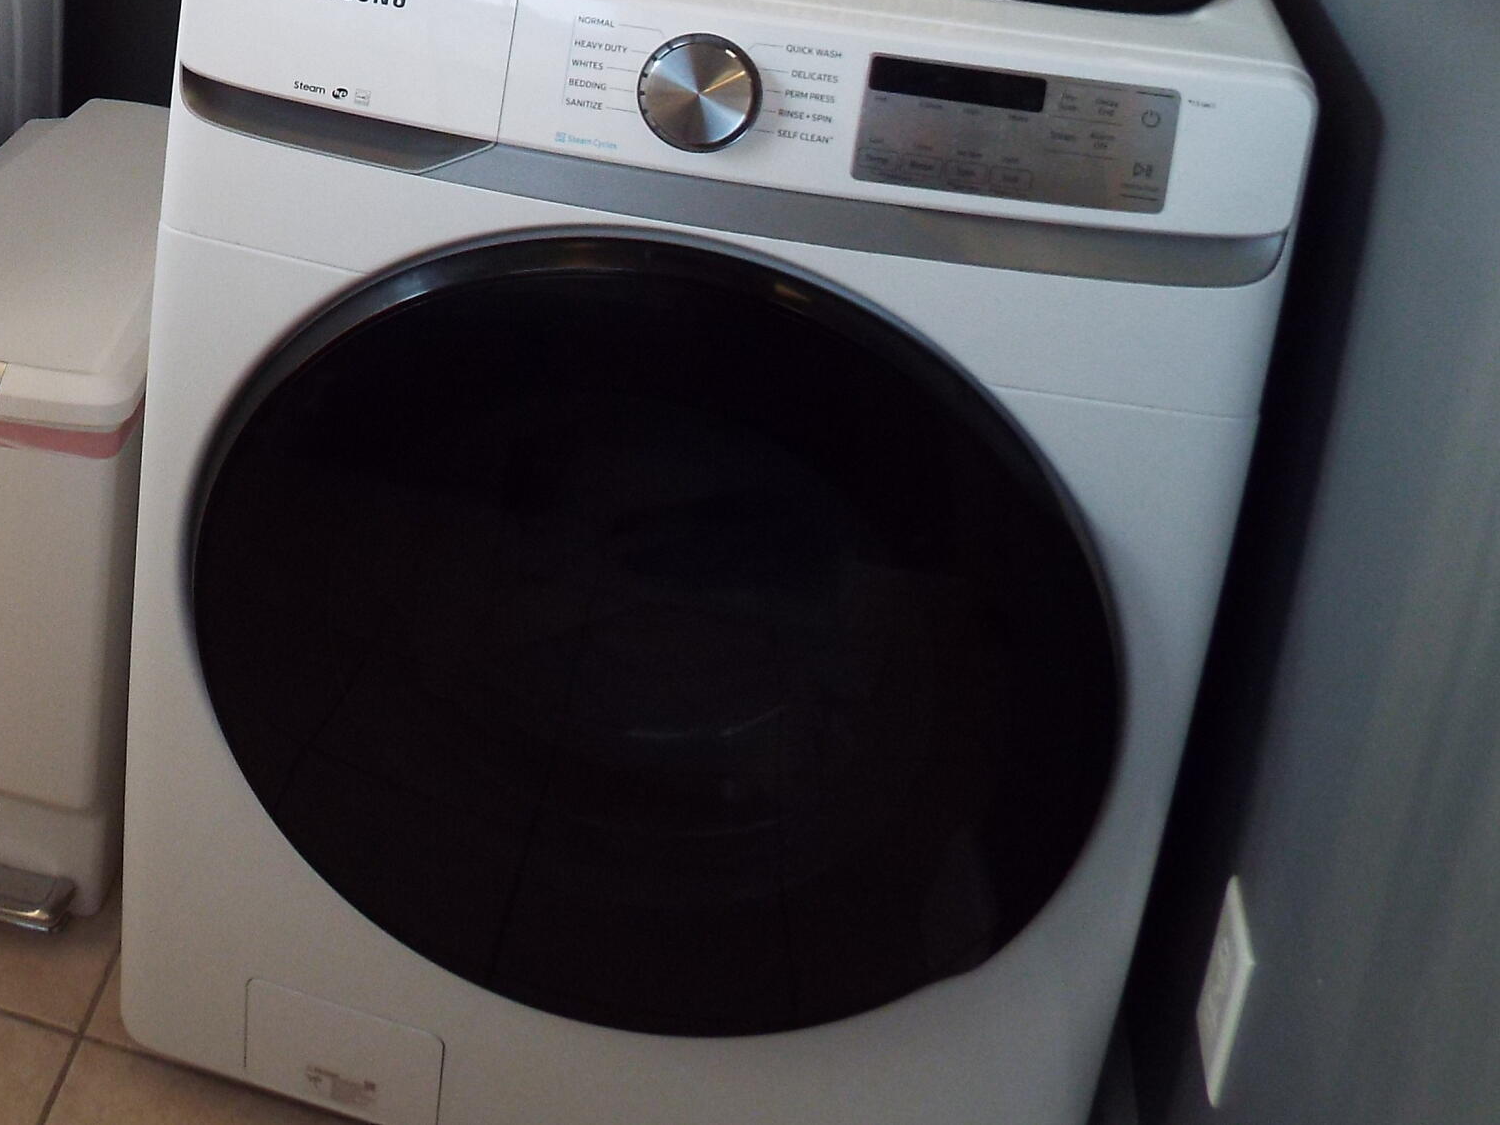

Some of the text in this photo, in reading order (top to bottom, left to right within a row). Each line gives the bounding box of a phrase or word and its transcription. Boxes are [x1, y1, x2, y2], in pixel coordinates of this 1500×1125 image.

[578, 16, 615, 28] NORMAL
[574, 39, 628, 53] HEAVY DUTY
[786, 44, 842, 59] QUICK WASH
[571, 59, 604, 71] WHITES
[791, 70, 839, 84] DELICATES
[293, 80, 326, 95] Steam
[568, 78, 607, 91] BEDDING
[565, 97, 603, 111] SANITIZE
[777, 129, 799, 140] SELF
